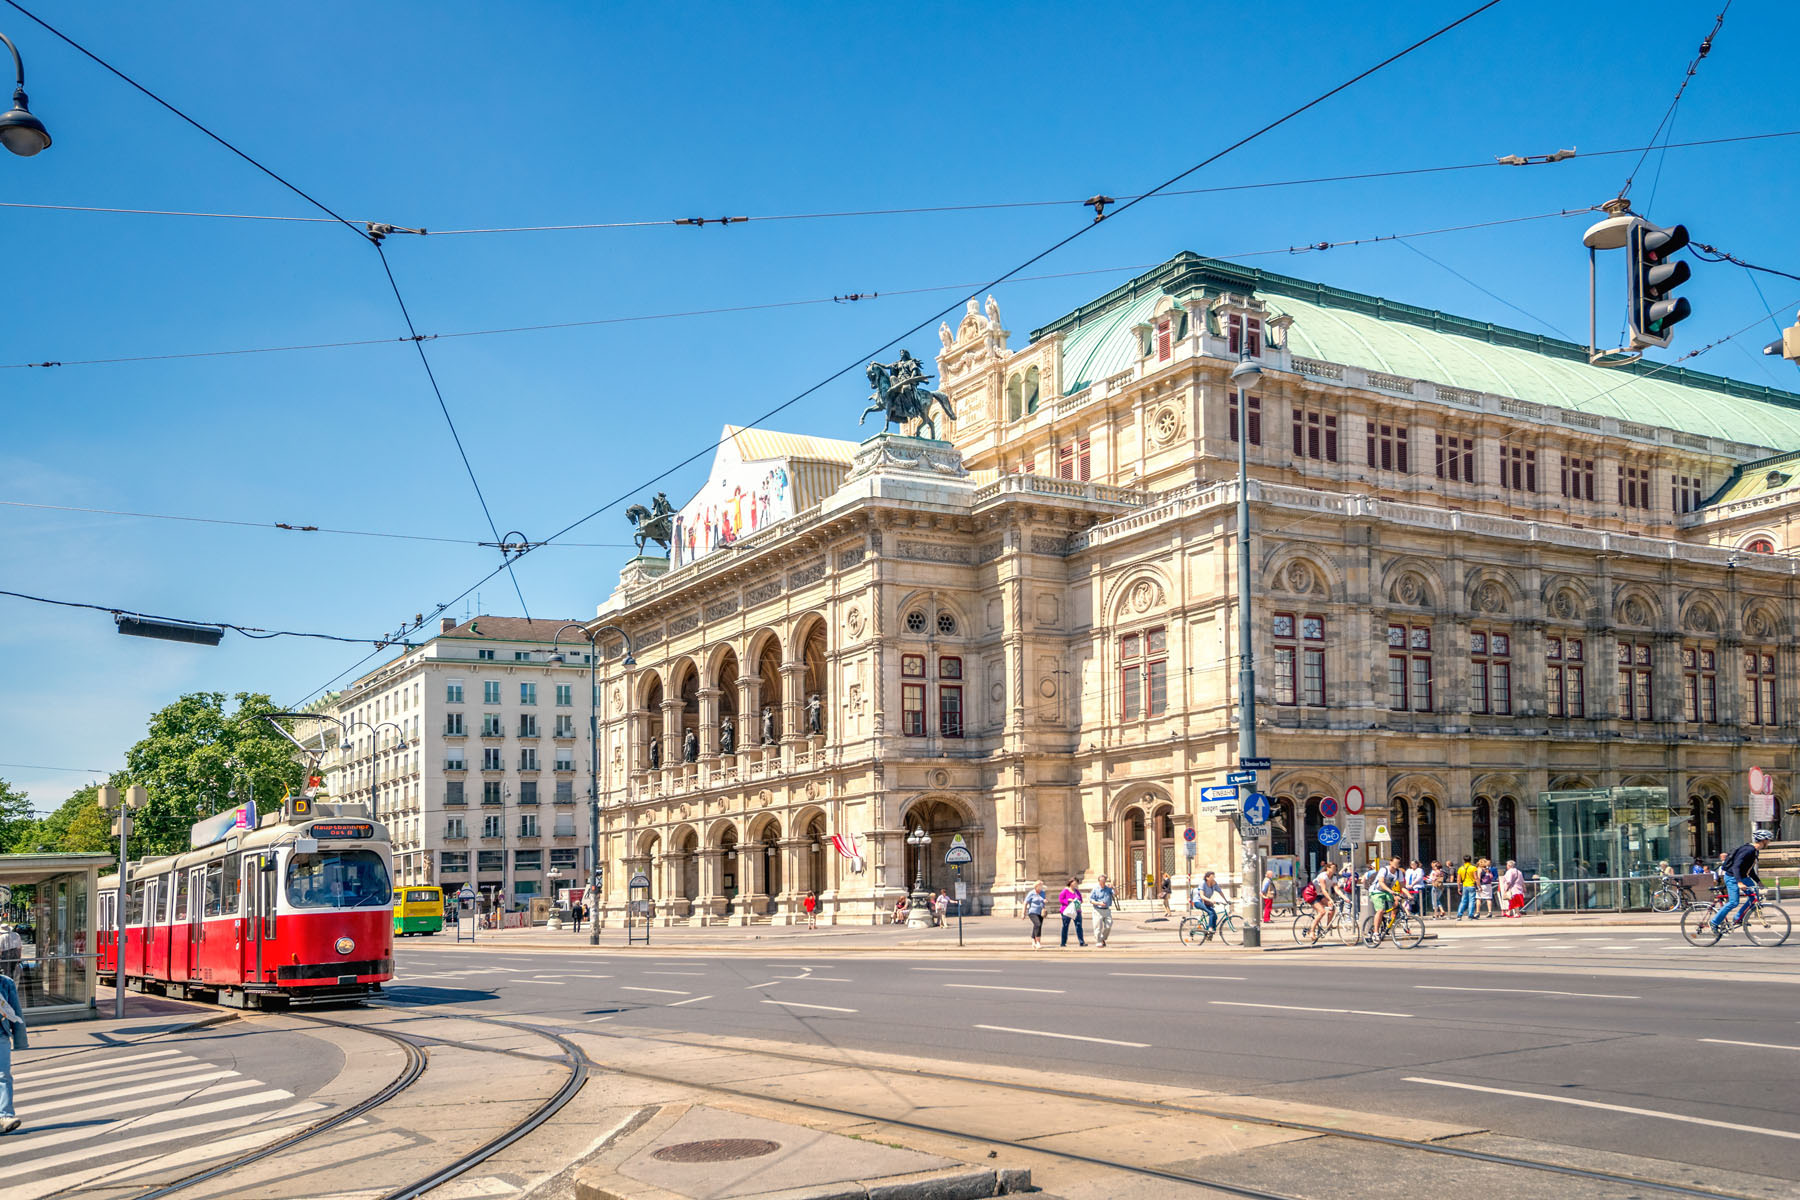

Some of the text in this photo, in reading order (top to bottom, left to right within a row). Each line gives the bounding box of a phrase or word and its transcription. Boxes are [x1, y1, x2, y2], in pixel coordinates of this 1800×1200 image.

[1212, 789, 1235, 798] EINBAHN
[296, 801, 306, 812] D
[1248, 826, 1267, 836] 100m
